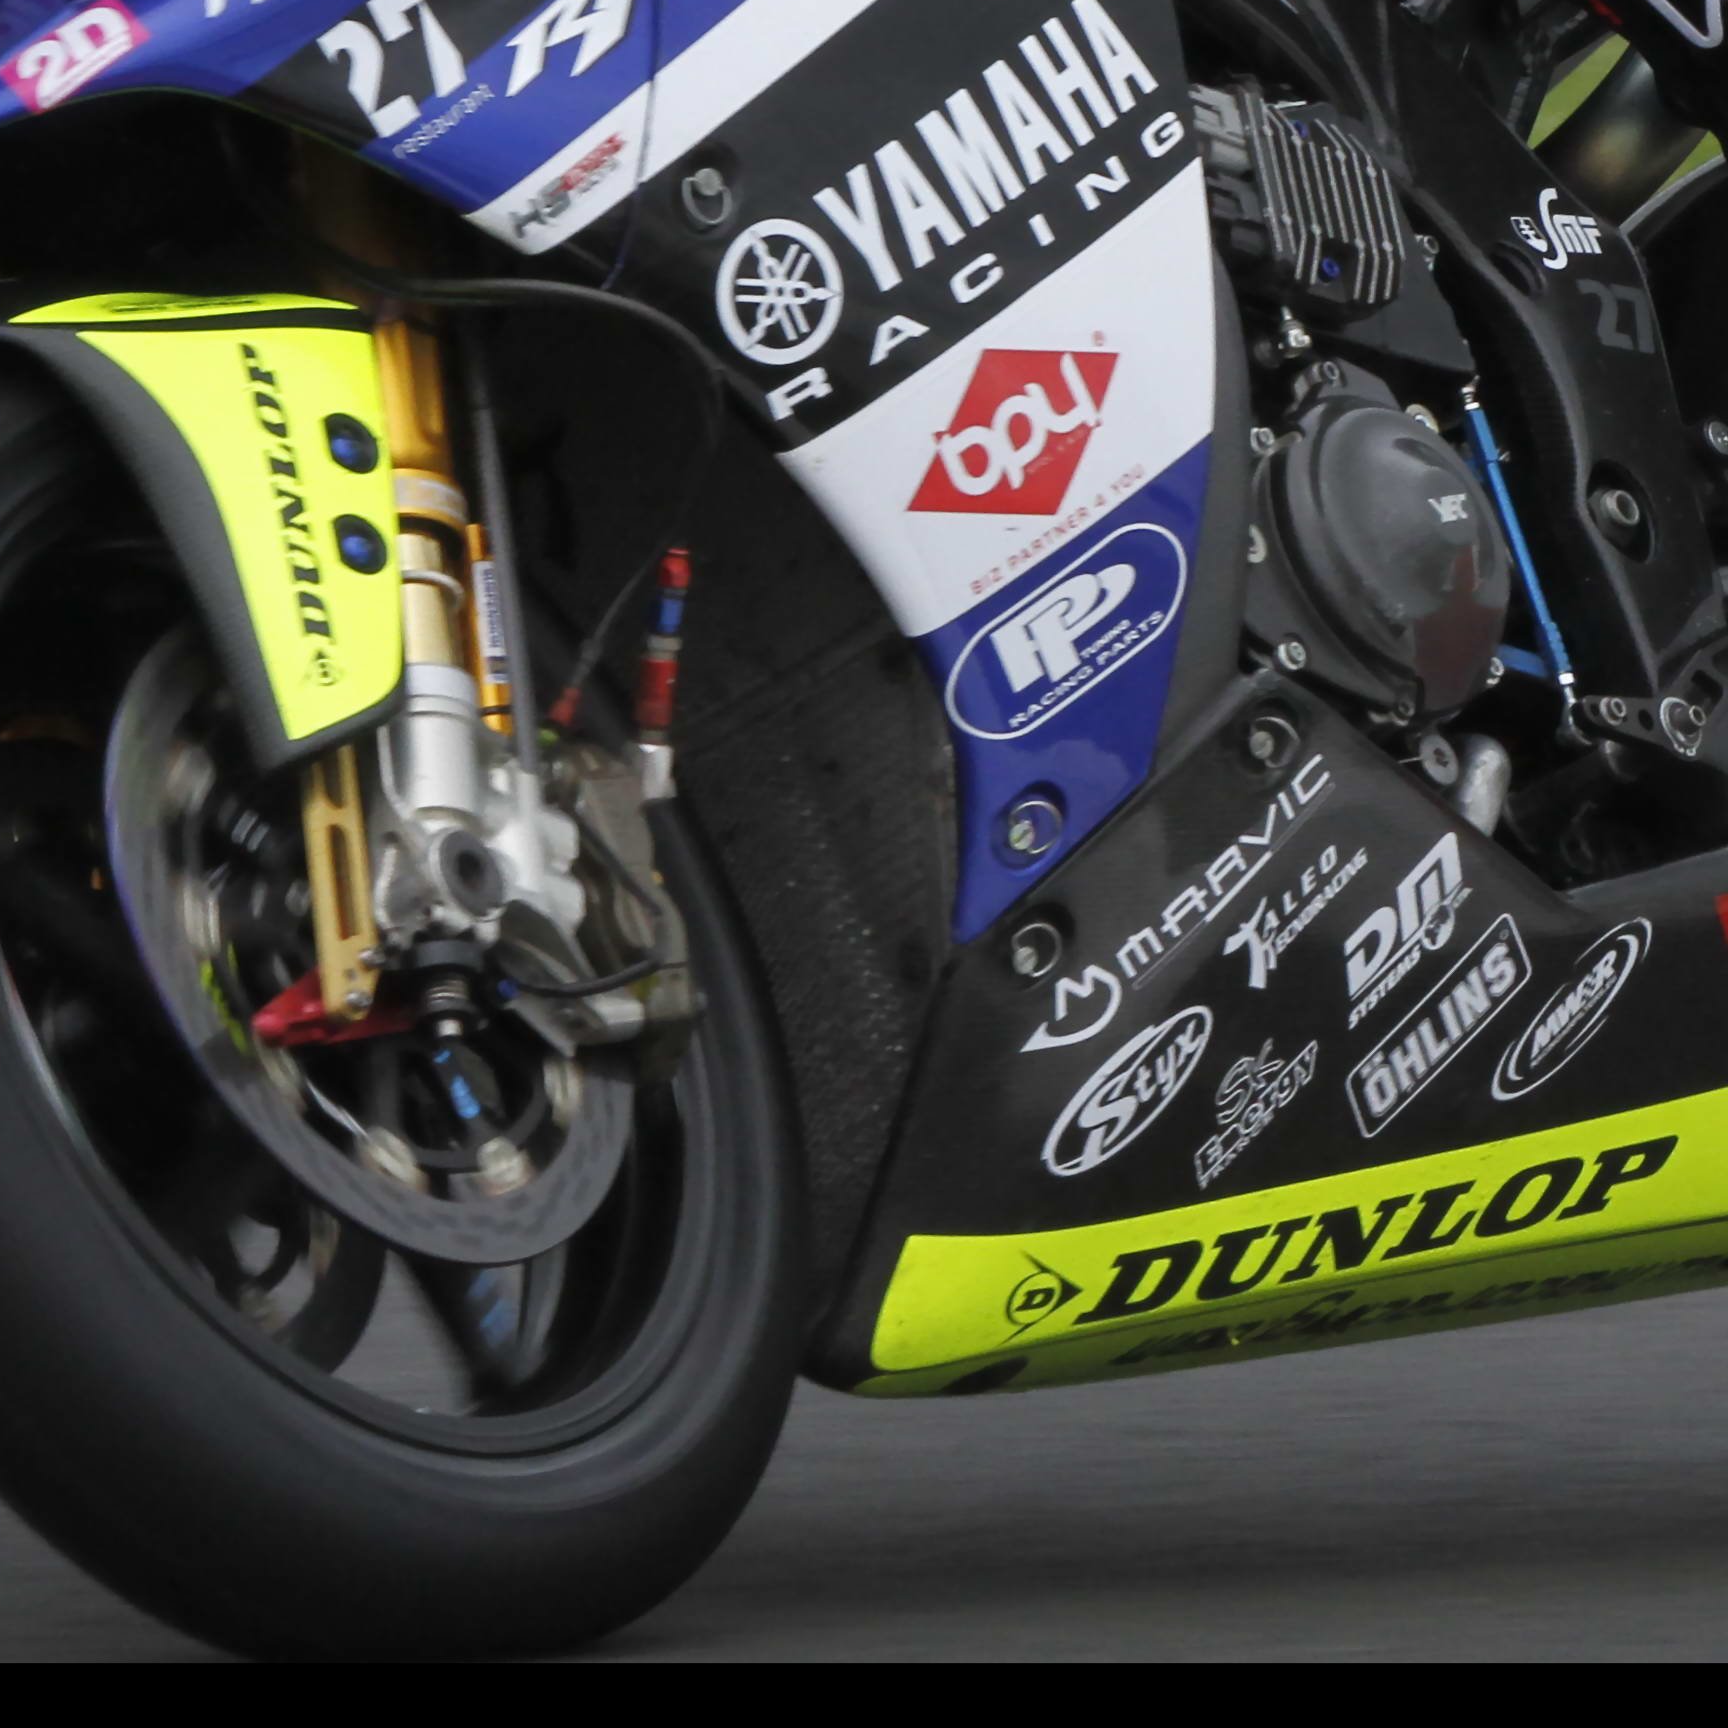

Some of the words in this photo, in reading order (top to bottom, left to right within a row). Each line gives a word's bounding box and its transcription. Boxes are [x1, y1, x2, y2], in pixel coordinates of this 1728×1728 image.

[15, 6, 131, 102] 2D
[391, 82, 497, 161] restaurant
[766, 111, 1186, 423] RACING
[1576, 277, 1656, 355] 27
[932, 351, 1102, 497] bpy
[239, 341, 338, 648] DUNLOP
[1007, 505, 1089, 569] PARTNER
[1110, 462, 1146, 494] YOU
[1008, 664, 1094, 728] RACING
[1096, 609, 1165, 666] PARTS
[1347, 943, 1423, 1032] SYSTEMS
[1369, 941, 1518, 1118] ÖHLINS
[1078, 1020, 1207, 1165] Styx
[1075, 1134, 1679, 1325] DUNLOP
